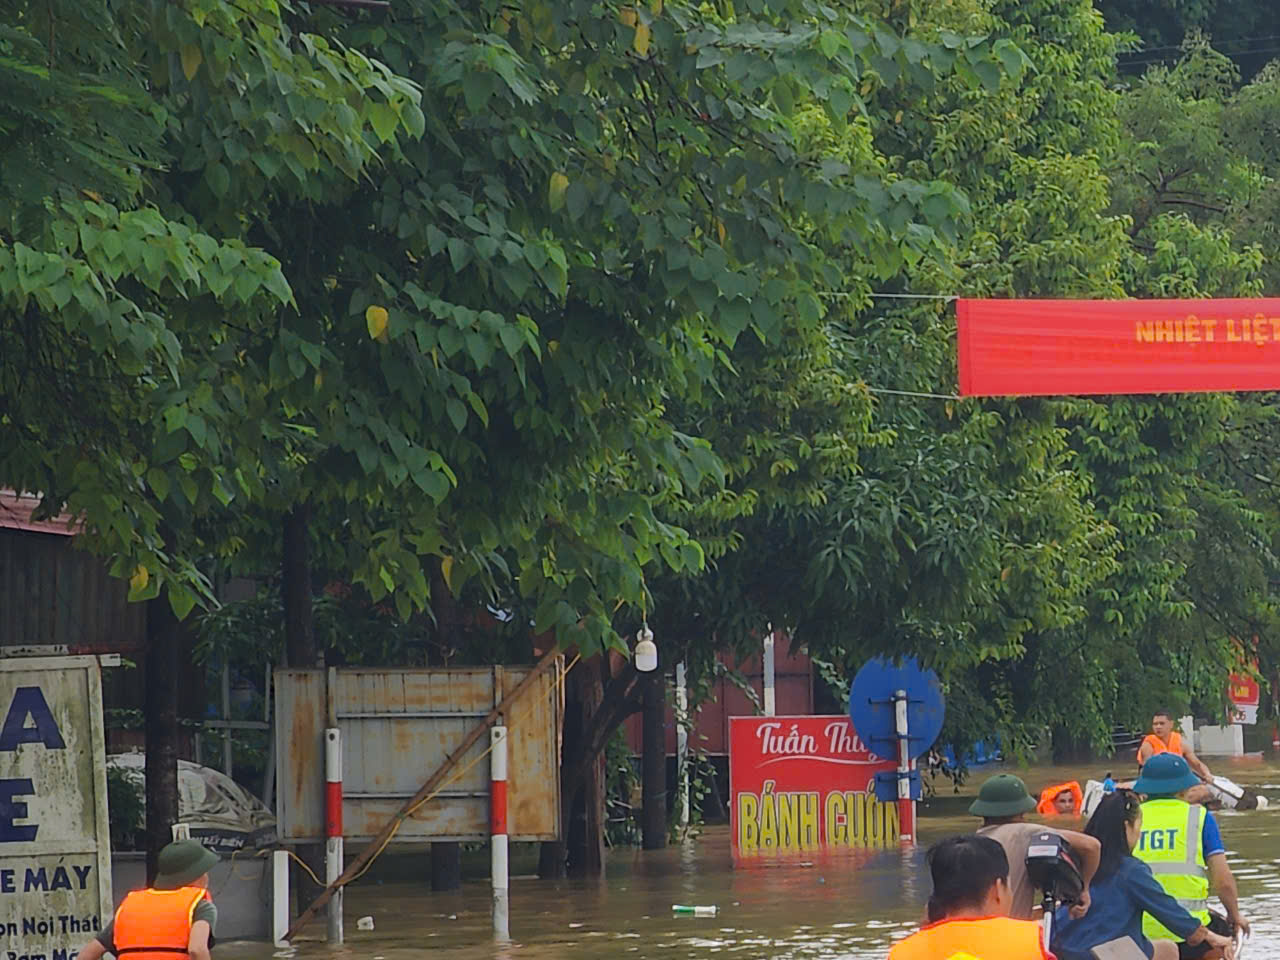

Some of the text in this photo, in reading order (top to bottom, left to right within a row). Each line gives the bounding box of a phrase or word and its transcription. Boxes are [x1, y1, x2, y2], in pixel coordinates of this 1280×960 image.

[1135, 314, 1217, 346] NHIỆT
[756, 721, 878, 762] Tuấn Thu
[737, 779, 821, 852] BÁNH
[23, 856, 93, 893] MÁY
